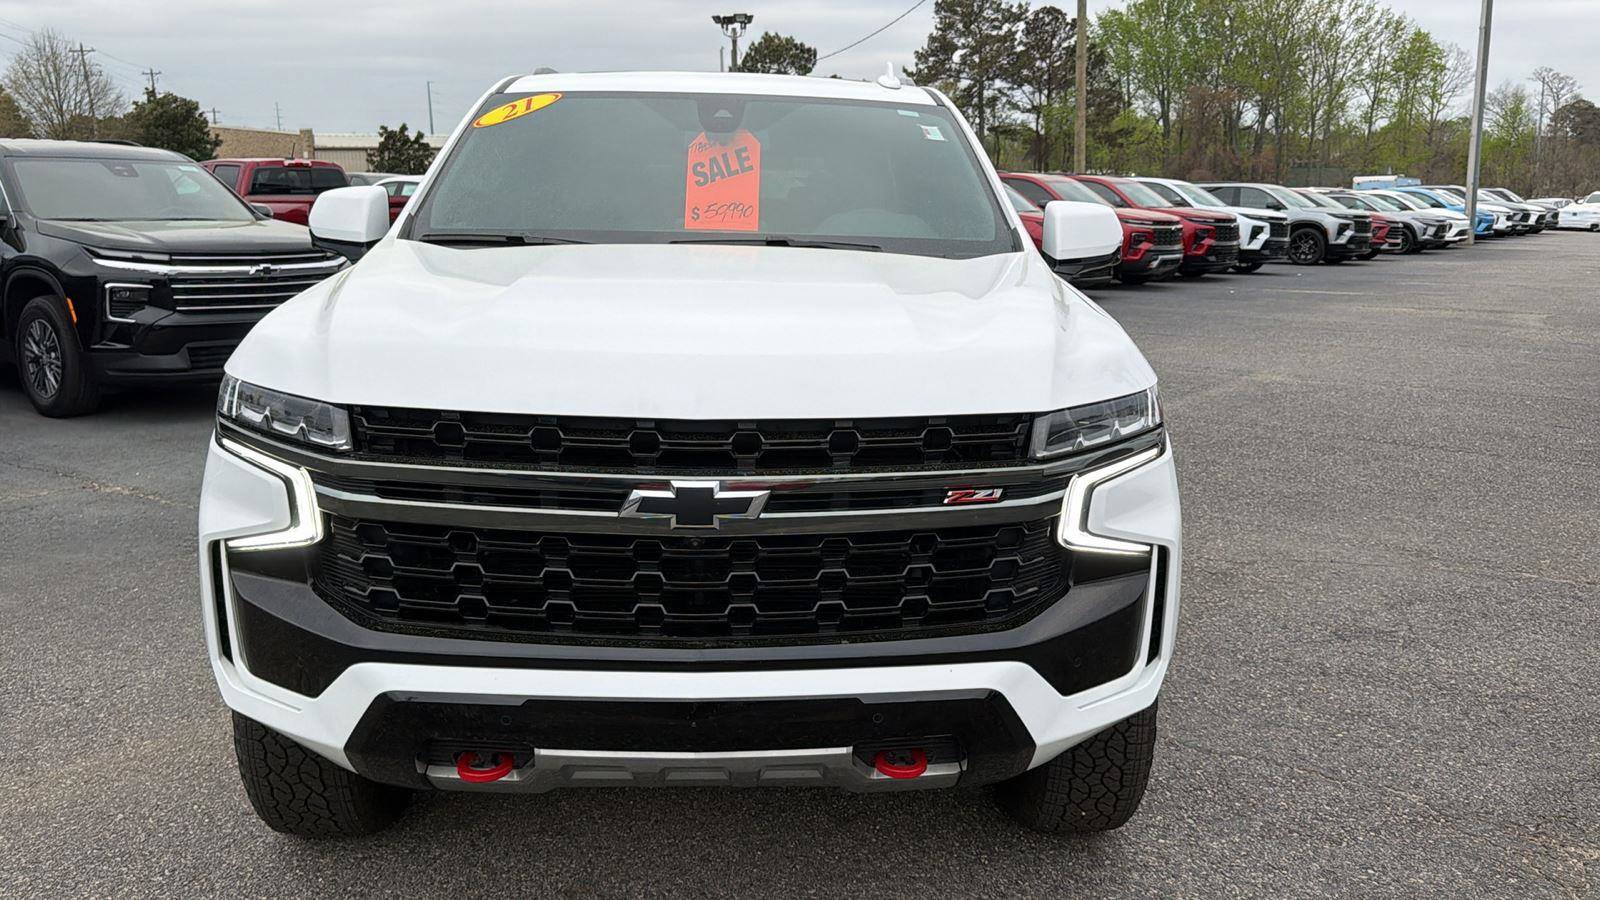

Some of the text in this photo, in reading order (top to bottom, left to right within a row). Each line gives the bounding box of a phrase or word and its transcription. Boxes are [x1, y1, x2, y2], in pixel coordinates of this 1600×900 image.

[502, 97, 533, 120] 21
[692, 146, 754, 187] SALE
[943, 488, 1003, 504] Z71
